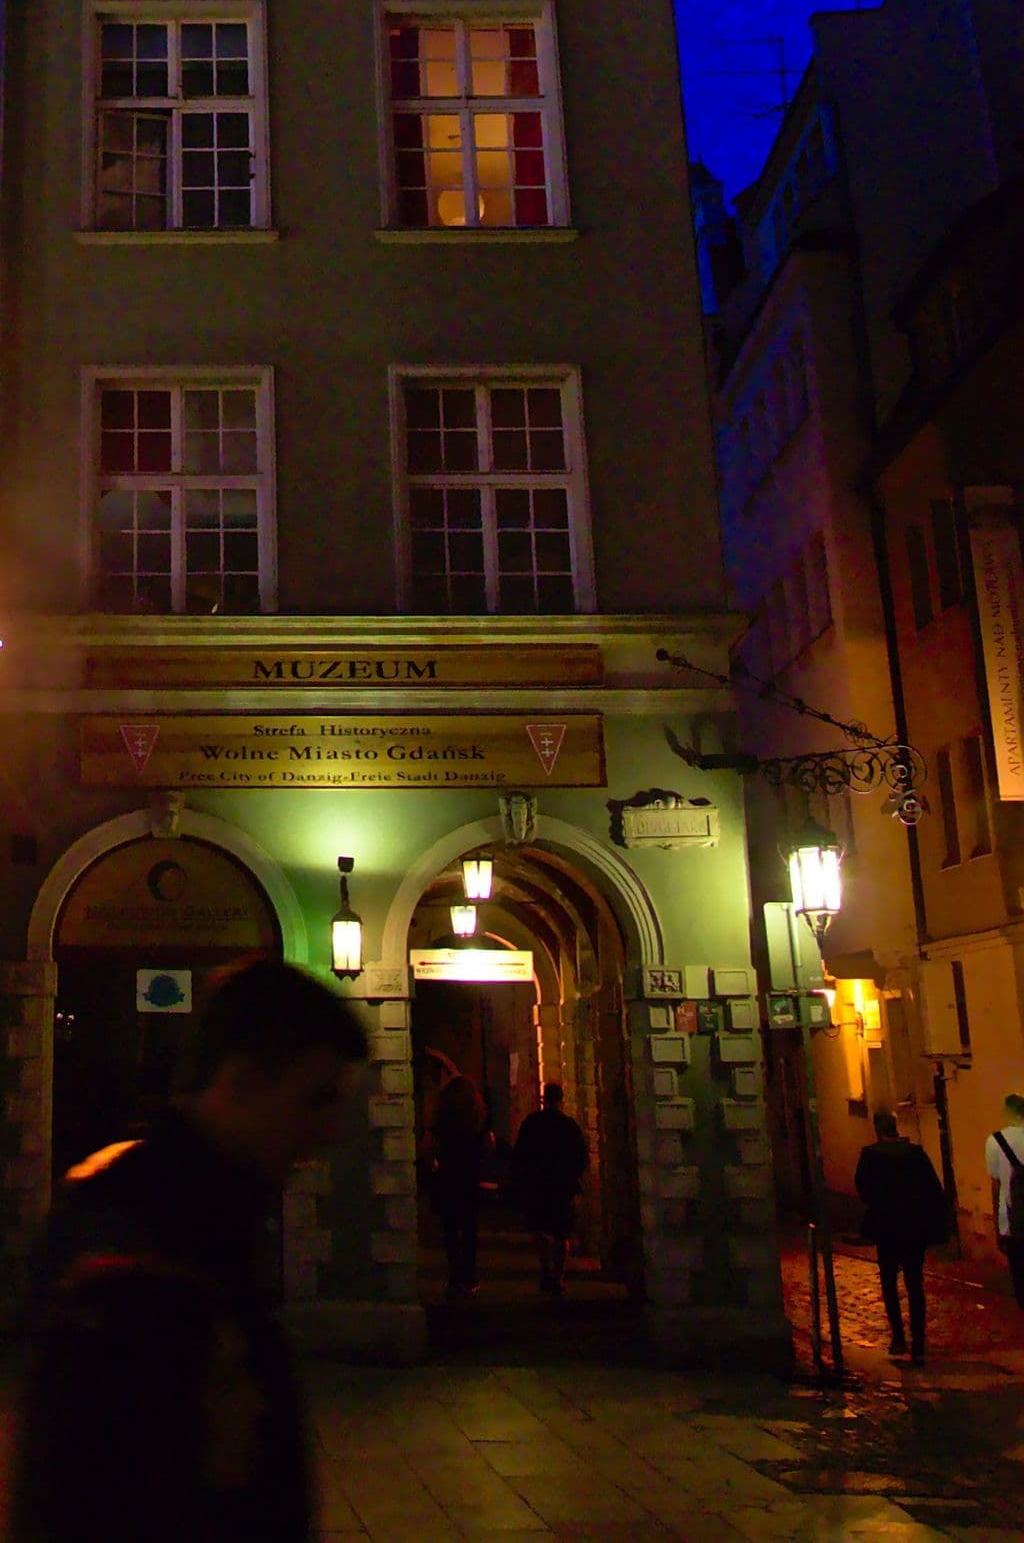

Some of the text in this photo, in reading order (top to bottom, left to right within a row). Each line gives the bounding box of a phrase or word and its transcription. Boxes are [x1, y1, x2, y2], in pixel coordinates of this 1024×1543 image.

[253, 660, 438, 679] MUZEUM
[253, 724, 432, 739] Strefa Historyczna
[199, 745, 486, 761] Wolne Miasto Gdańsk
